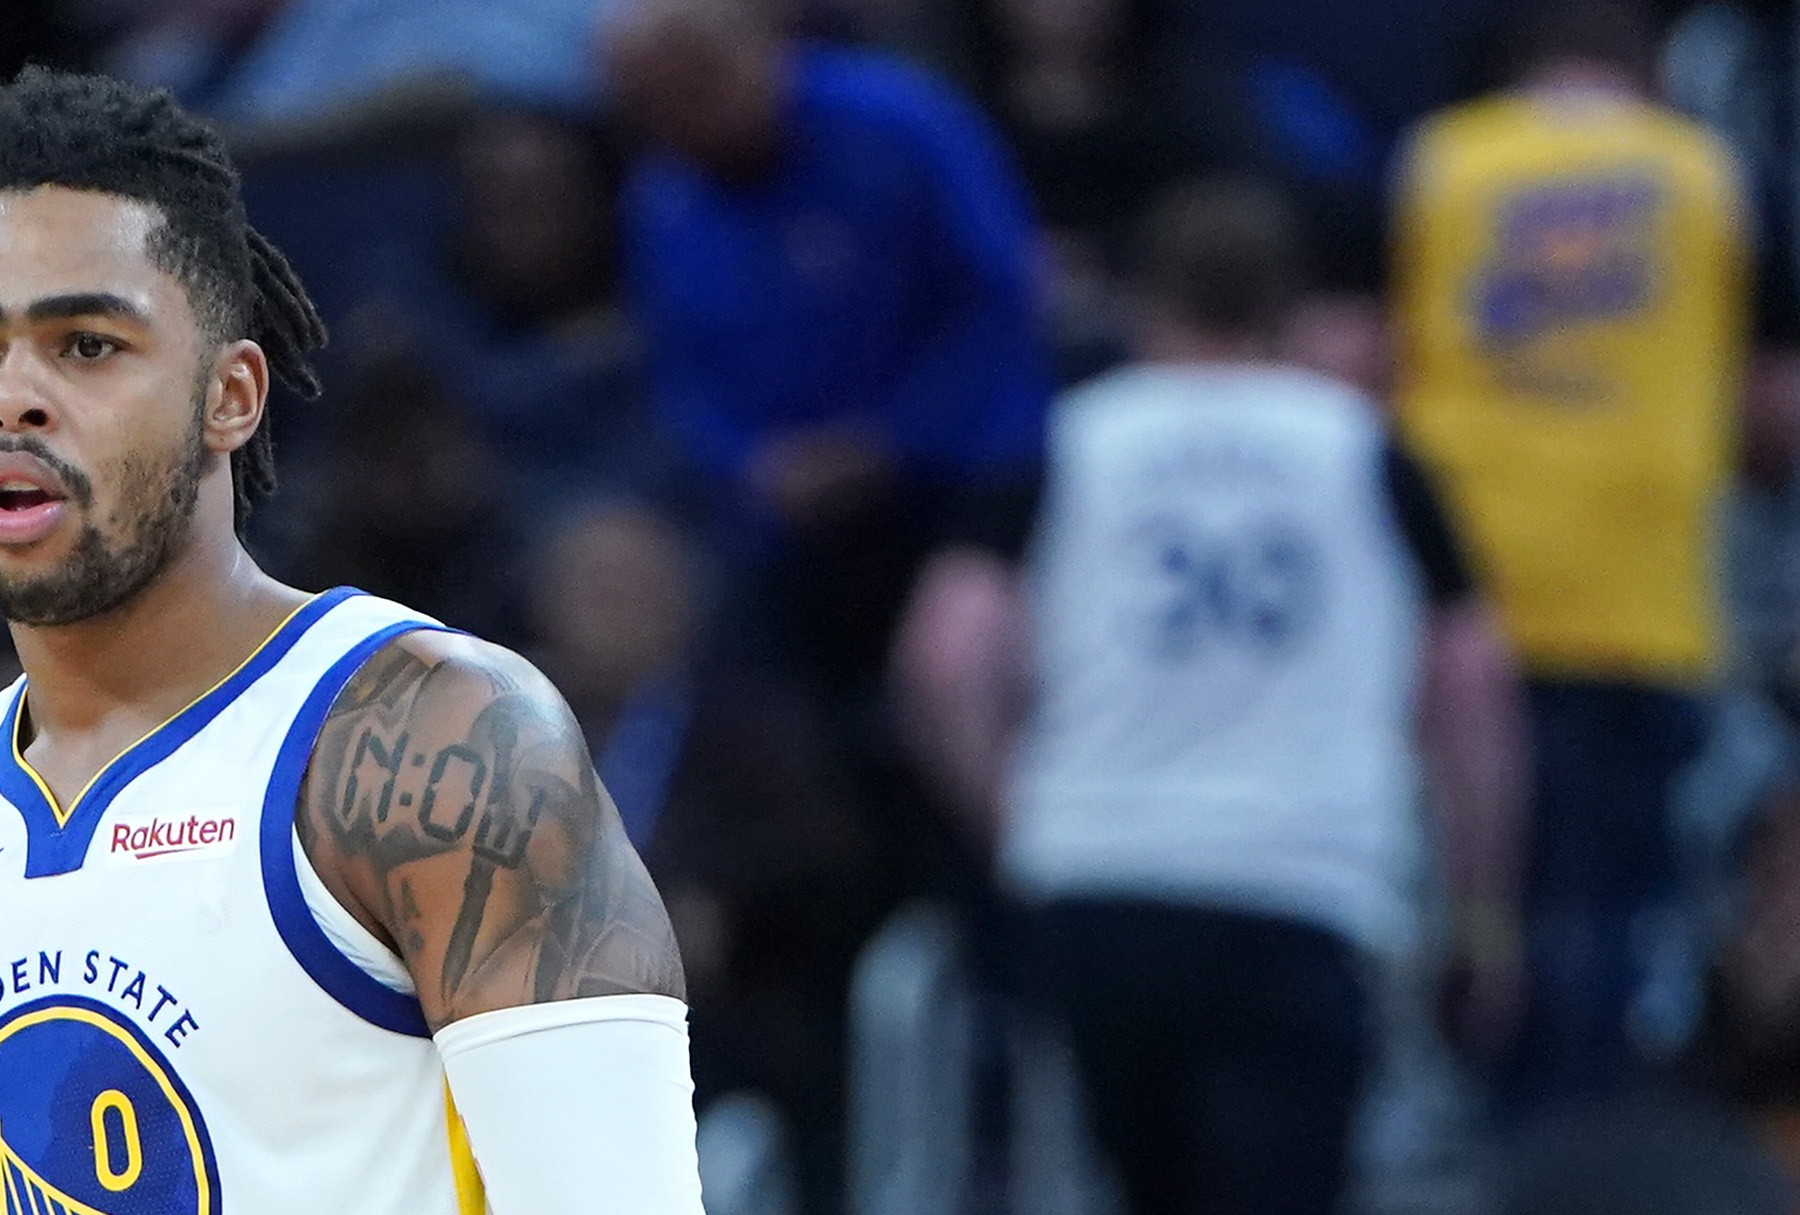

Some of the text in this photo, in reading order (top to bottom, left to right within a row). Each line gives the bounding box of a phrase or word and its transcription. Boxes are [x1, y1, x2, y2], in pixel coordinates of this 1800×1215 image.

[110, 816, 235, 856] Rakuten
[84, 950, 200, 1049] STATE
[91, 1089, 142, 1192] 0
